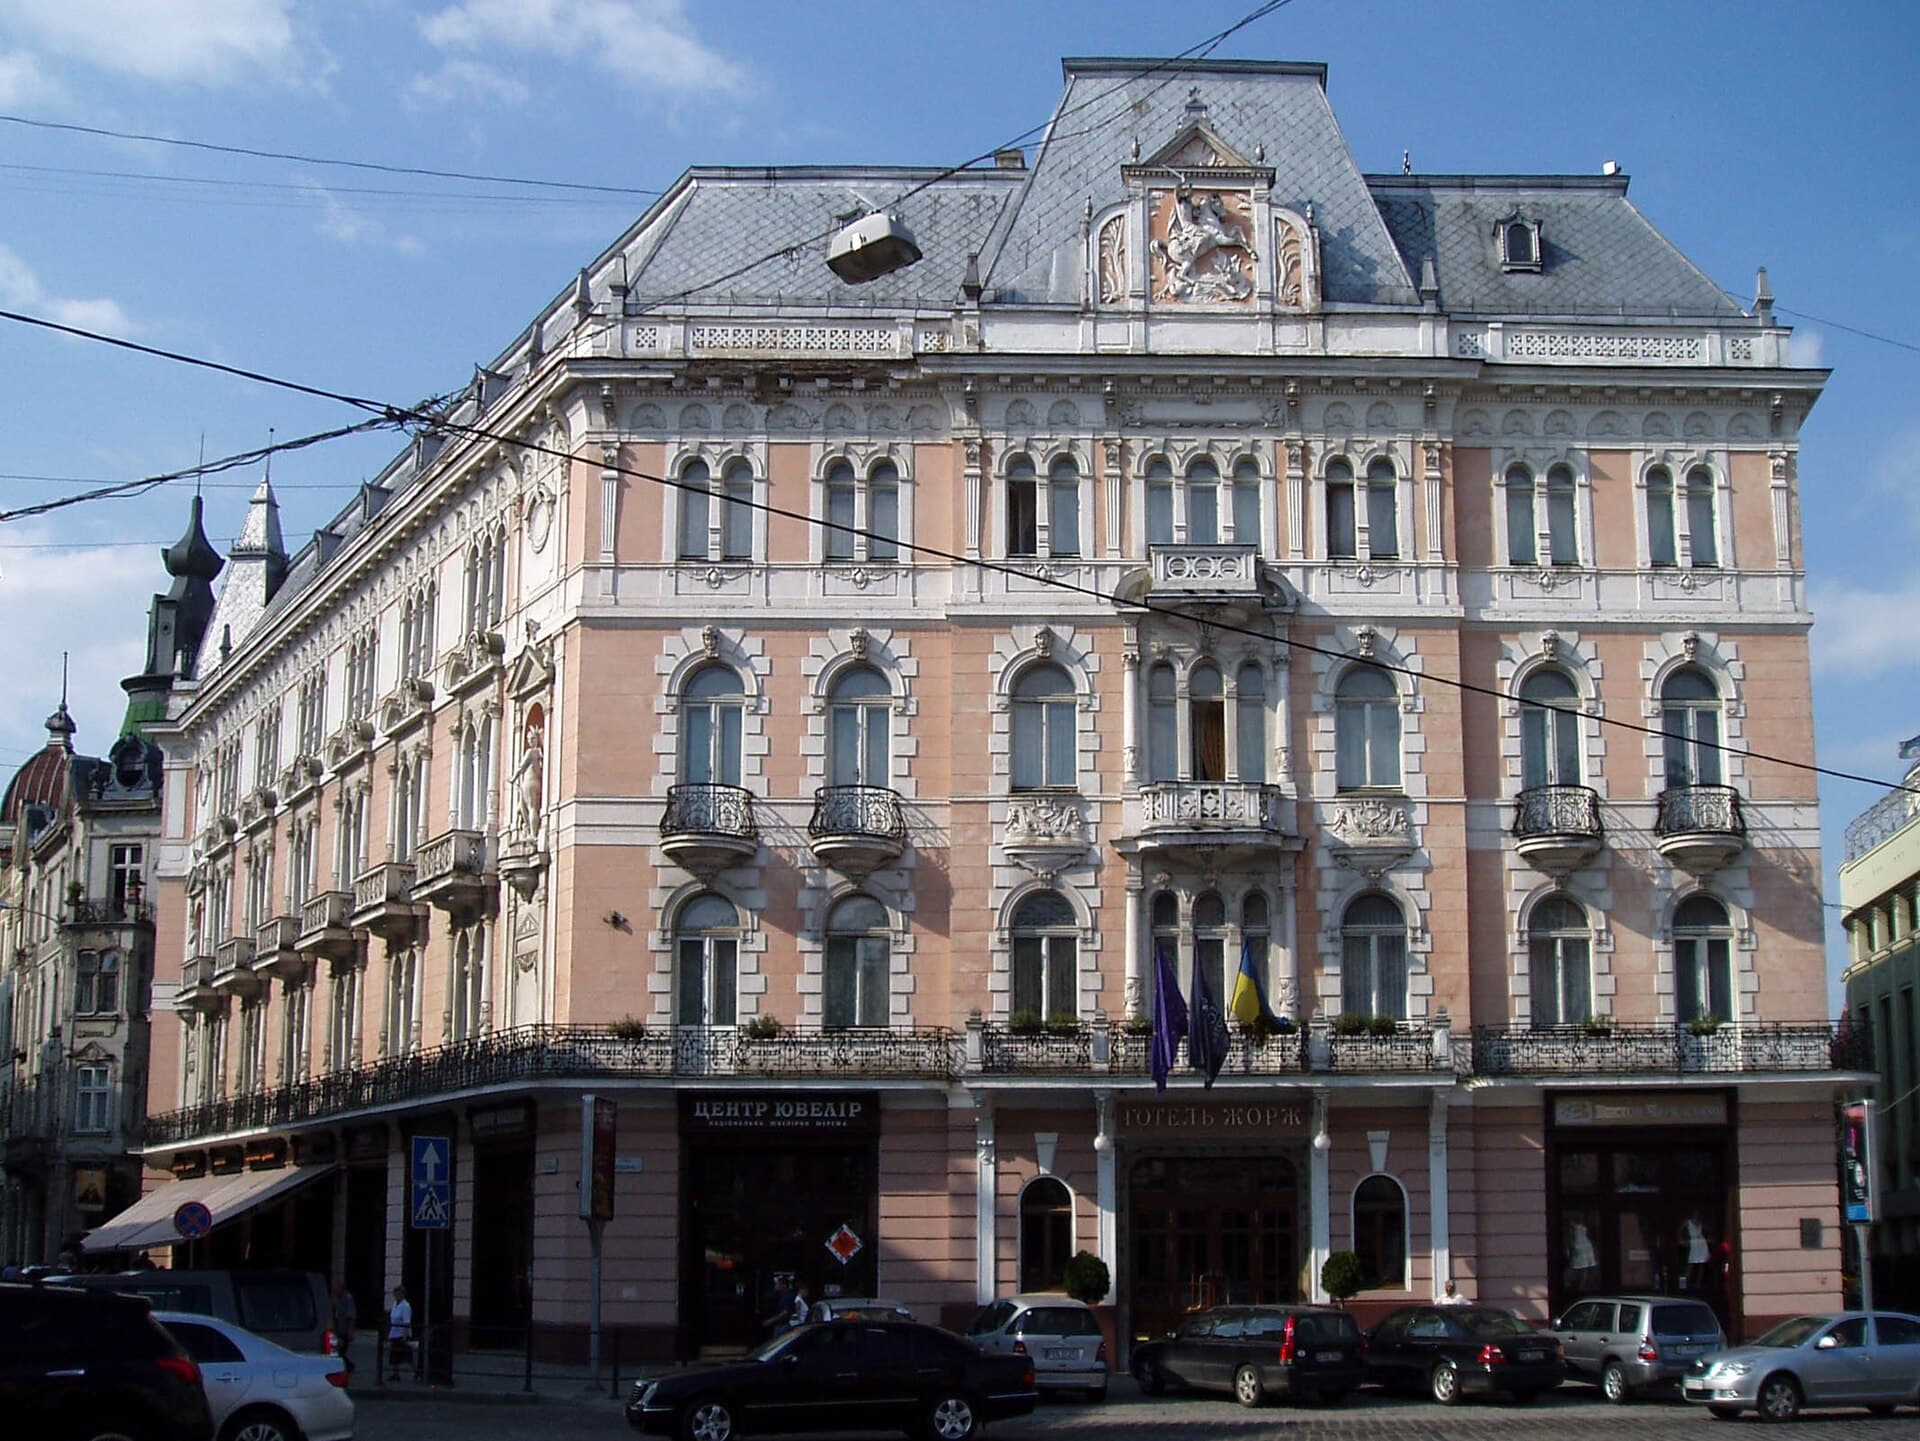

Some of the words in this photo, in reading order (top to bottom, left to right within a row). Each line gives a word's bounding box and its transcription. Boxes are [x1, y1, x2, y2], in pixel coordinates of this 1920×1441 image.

[694, 1101, 768, 1119] ЦЕНТР
[775, 1101, 862, 1118] ЮВЕЛІР
[1124, 1107, 1215, 1127] ГОТЕЛЬ
[1223, 1107, 1302, 1126] ЖОРЖ
